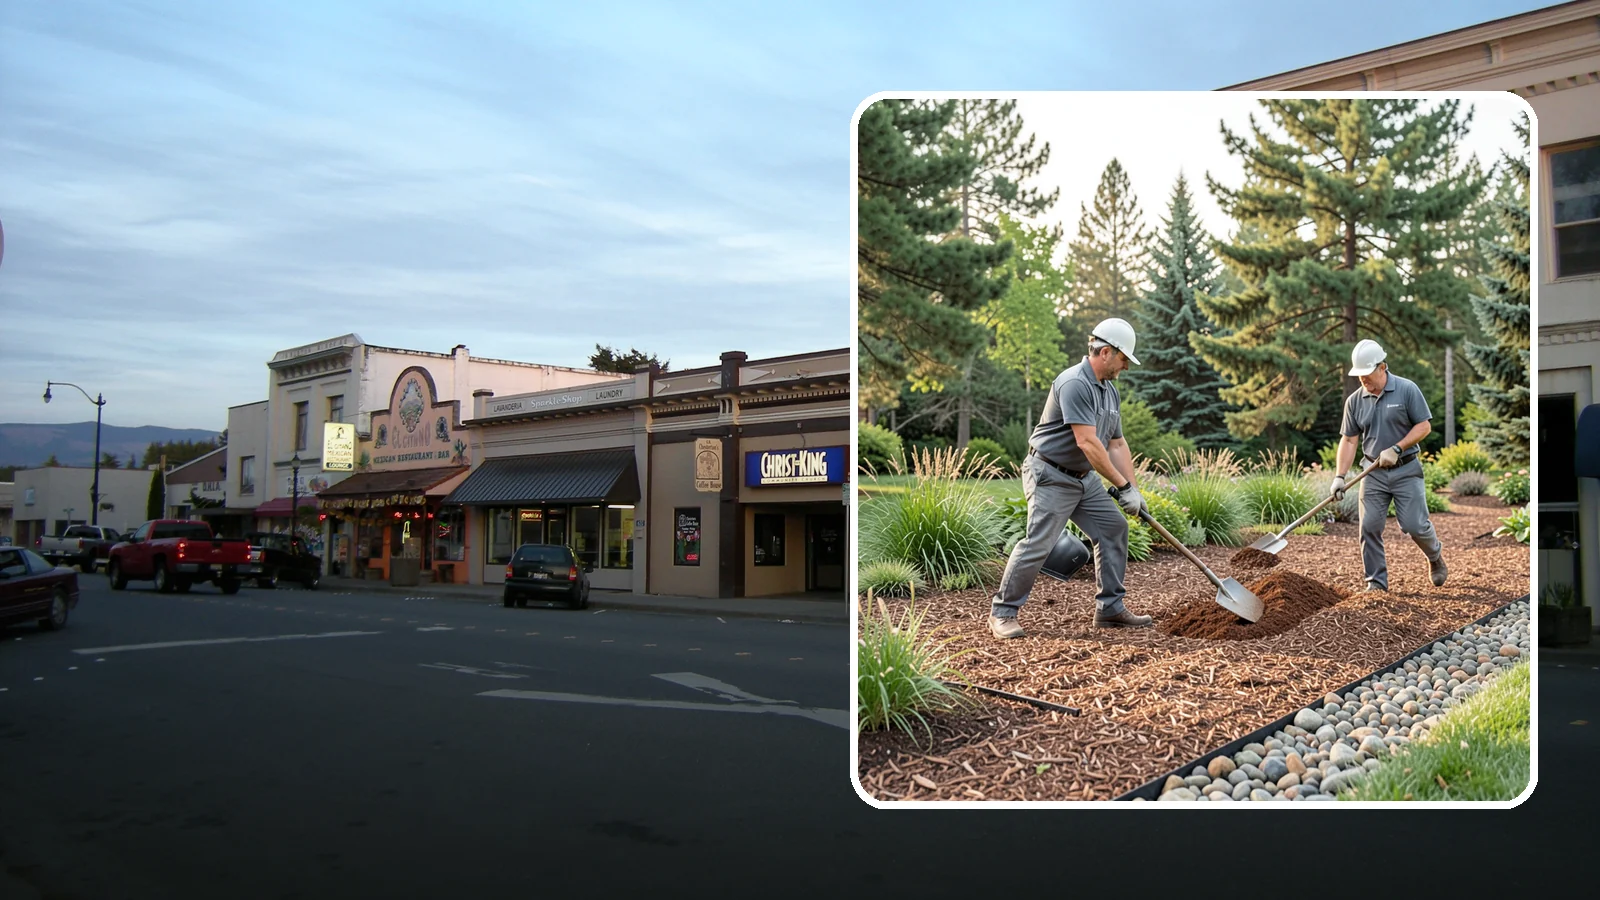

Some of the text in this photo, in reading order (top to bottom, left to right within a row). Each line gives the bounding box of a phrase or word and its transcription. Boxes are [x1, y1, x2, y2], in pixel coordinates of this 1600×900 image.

[562, 395, 582, 404] Shop
[595, 389, 624, 400] LAUNDRY
[493, 402, 522, 413] LAVANDERIA
[373, 450, 450, 464] MEXICAN RESTAURANT BAR
[761, 450, 827, 478] CHRIST KING
